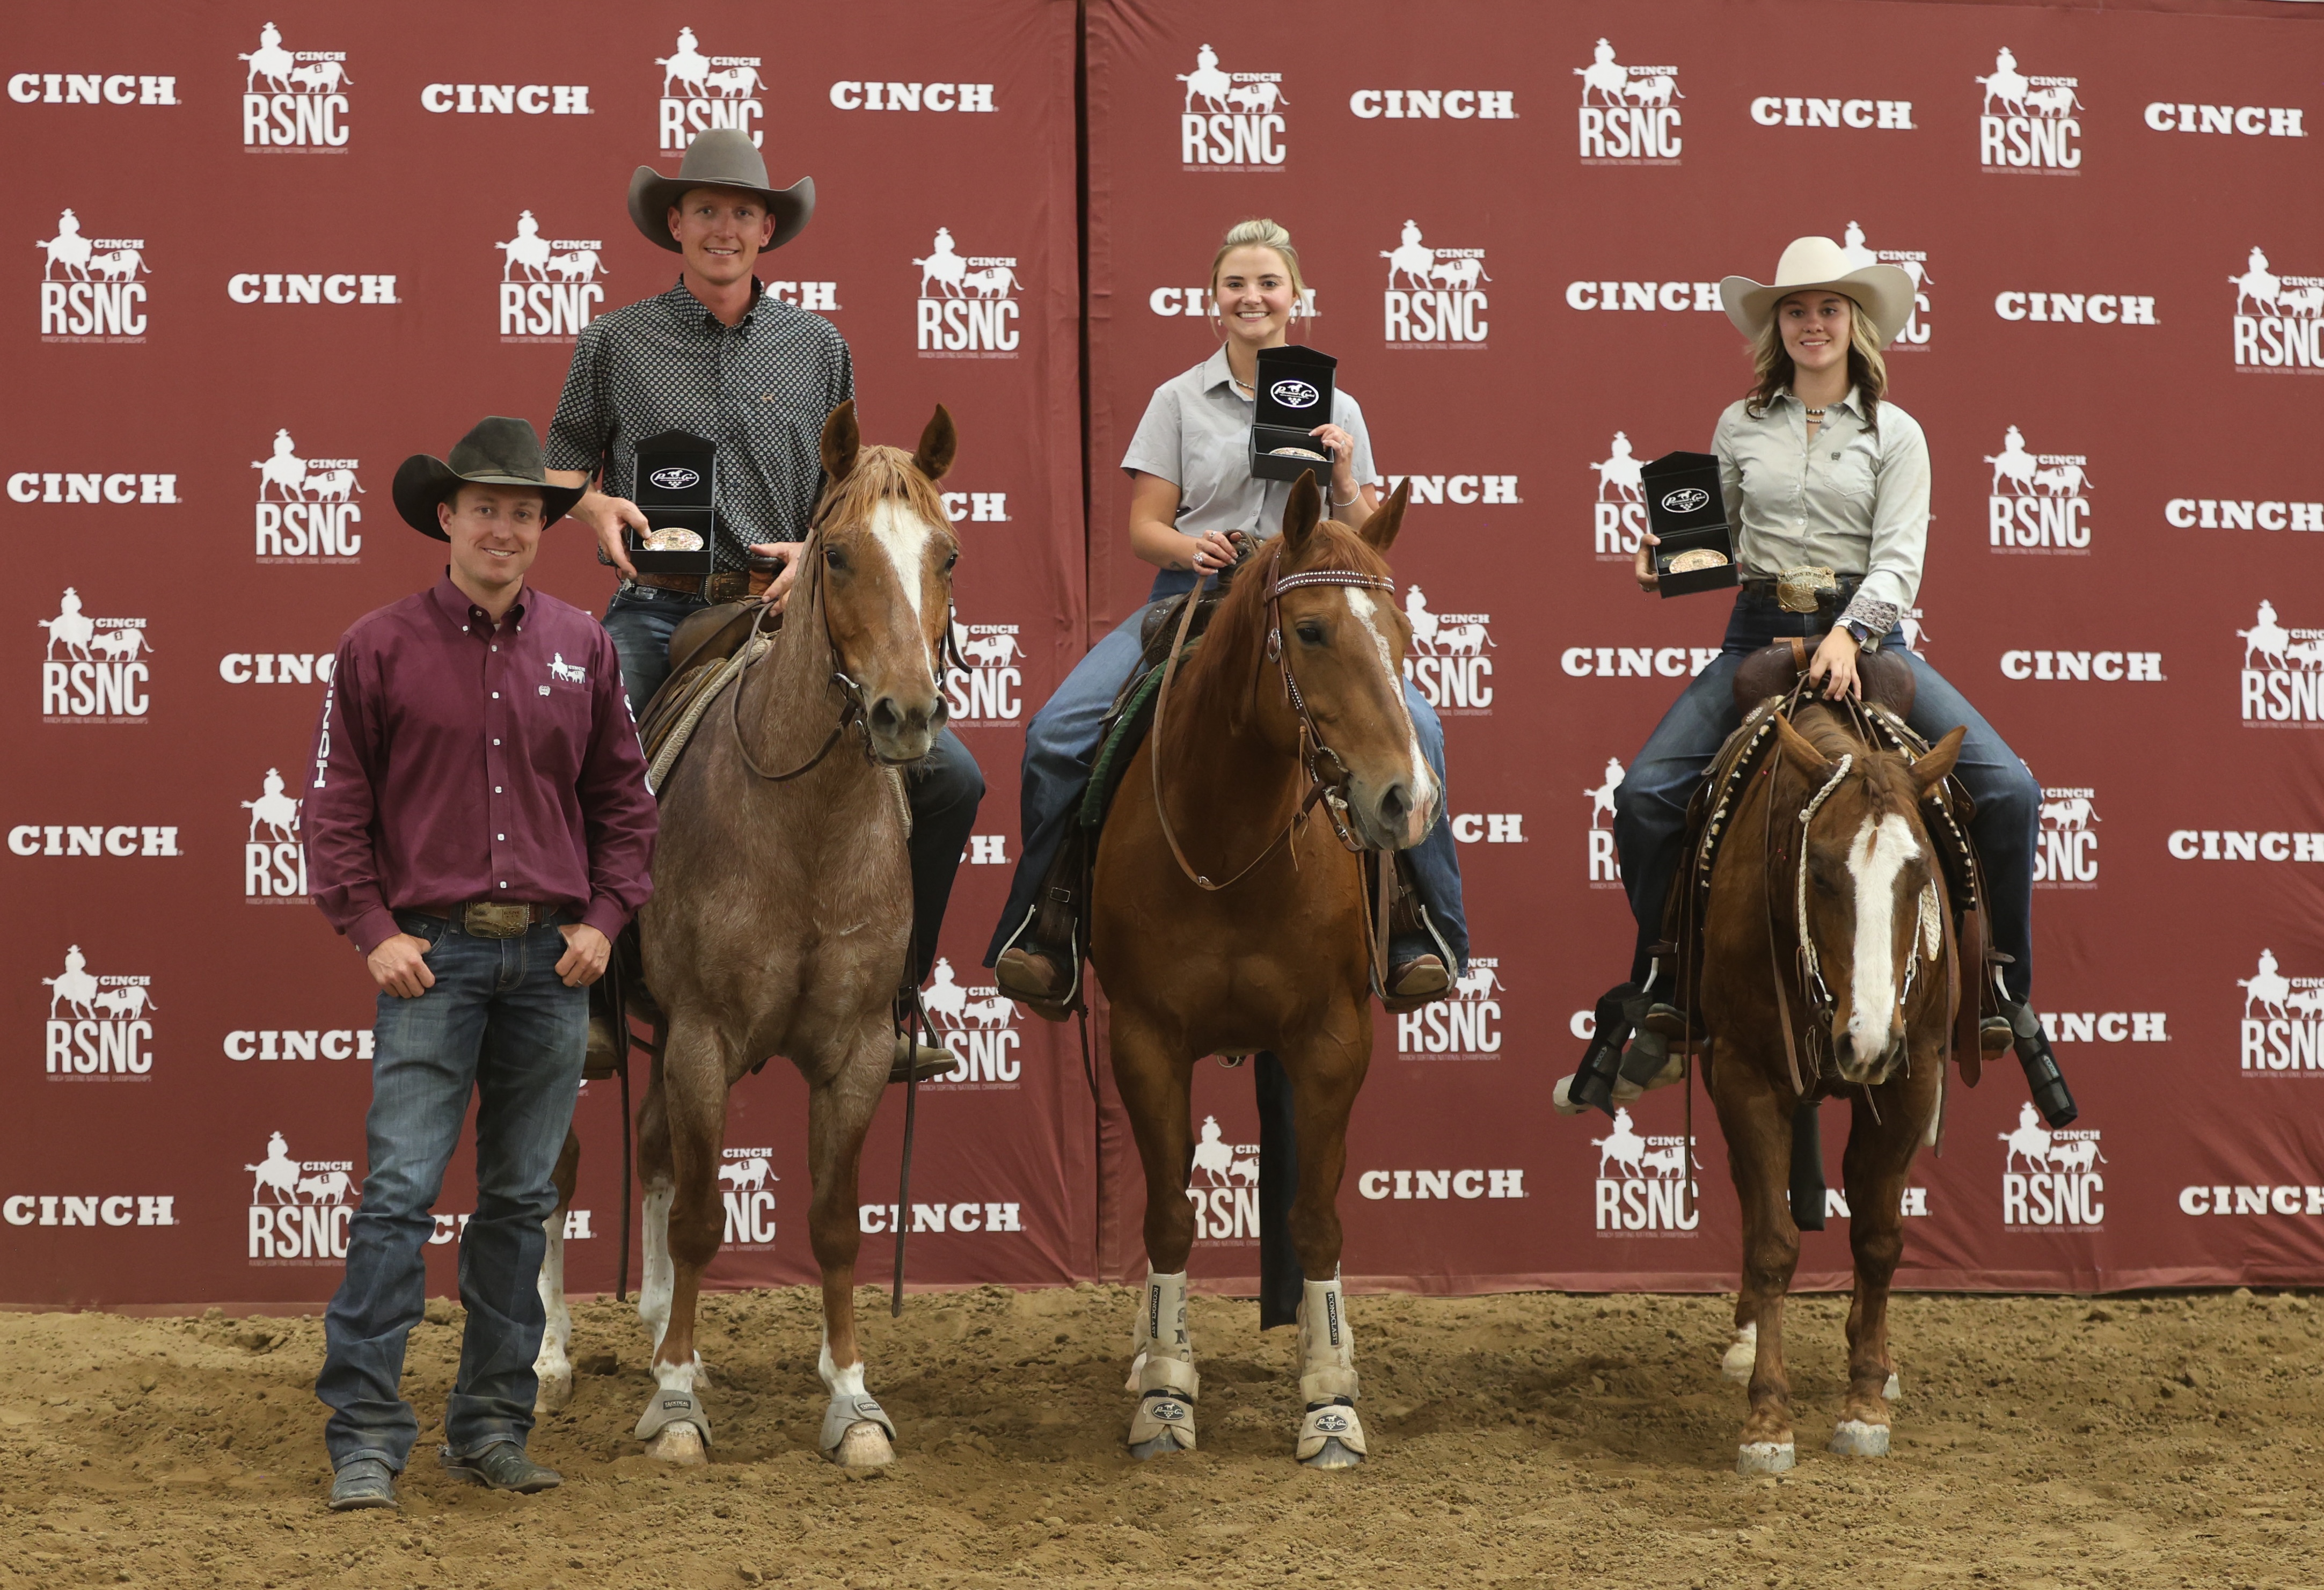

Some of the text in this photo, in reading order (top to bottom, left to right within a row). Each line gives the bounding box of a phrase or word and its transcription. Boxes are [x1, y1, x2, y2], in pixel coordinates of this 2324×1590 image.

[295, 52, 346, 61] CINCH
[711, 56, 761, 66] CINCH
[1629, 66, 1678, 76] CINCH
[8, 74, 176, 105] CINCH
[1232, 73, 1282, 83] CINCH
[2030, 76, 2078, 87] CINCH
[421, 84, 588, 114] CINCH
[830, 81, 993, 112] CINCH
[1350, 90, 1514, 119] CINCH
[243, 94, 349, 145] RSNC
[1750, 97, 1911, 129] CINCH
[2144, 102, 2302, 137] CINCH
[1181, 114, 1287, 165] RSNC
[1579, 107, 1682, 158] RSNC
[1980, 116, 2082, 169] RSNC
[93, 239, 144, 249] CINCH
[552, 240, 602, 250] CINCH
[1436, 249, 1485, 258] CINCH
[1878, 250, 1927, 260] CINCH
[968, 257, 1017, 267] CINCH
[228, 274, 396, 304] CINCH
[41, 282, 147, 334] RSNC
[500, 283, 604, 334] RSNC
[1385, 290, 1488, 342] RSNC
[1995, 291, 2155, 325] CINCH
[917, 299, 1019, 351] RSNC
[308, 460, 359, 469] CINCH
[2038, 455, 2087, 465] CINCH
[7, 472, 176, 504] CINCH
[256, 503, 361, 555] RSNC
[1595, 502, 1649, 553] RS
[1990, 497, 2091, 548] RSNC
[2165, 498, 2324, 531] CINCH
[96, 618, 147, 628] CINCH
[970, 625, 1019, 634] CINCH
[1440, 614, 1489, 624] CINCH
[2000, 650, 2162, 681] CINCH
[43, 662, 149, 714] RSNC
[947, 668, 1022, 719] SNC
[2241, 670, 2324, 721] RSN
[2047, 787, 2094, 798] CINCH
[8, 825, 178, 856] CINCH
[2032, 831, 2098, 881] SNC
[2168, 830, 2324, 862] CINCH
[100, 976, 150, 985] CINCH
[2040, 1012, 2166, 1042] INCH
[47, 1020, 152, 1073] RSNC
[1236, 1145, 1260, 1154] CIN
[2053, 1130, 2100, 1140] CINCH
[303, 1162, 352, 1171] CINCH
[723, 1148, 772, 1158] CINCH
[1359, 1170, 1523, 1199] CINCH
[2004, 1173, 2105, 1226] RSNC
[3, 1195, 174, 1226] CINCH
[1597, 1180, 1699, 1231] RSNC
[1328, 1293, 1338, 1343] ICONOCLAST
